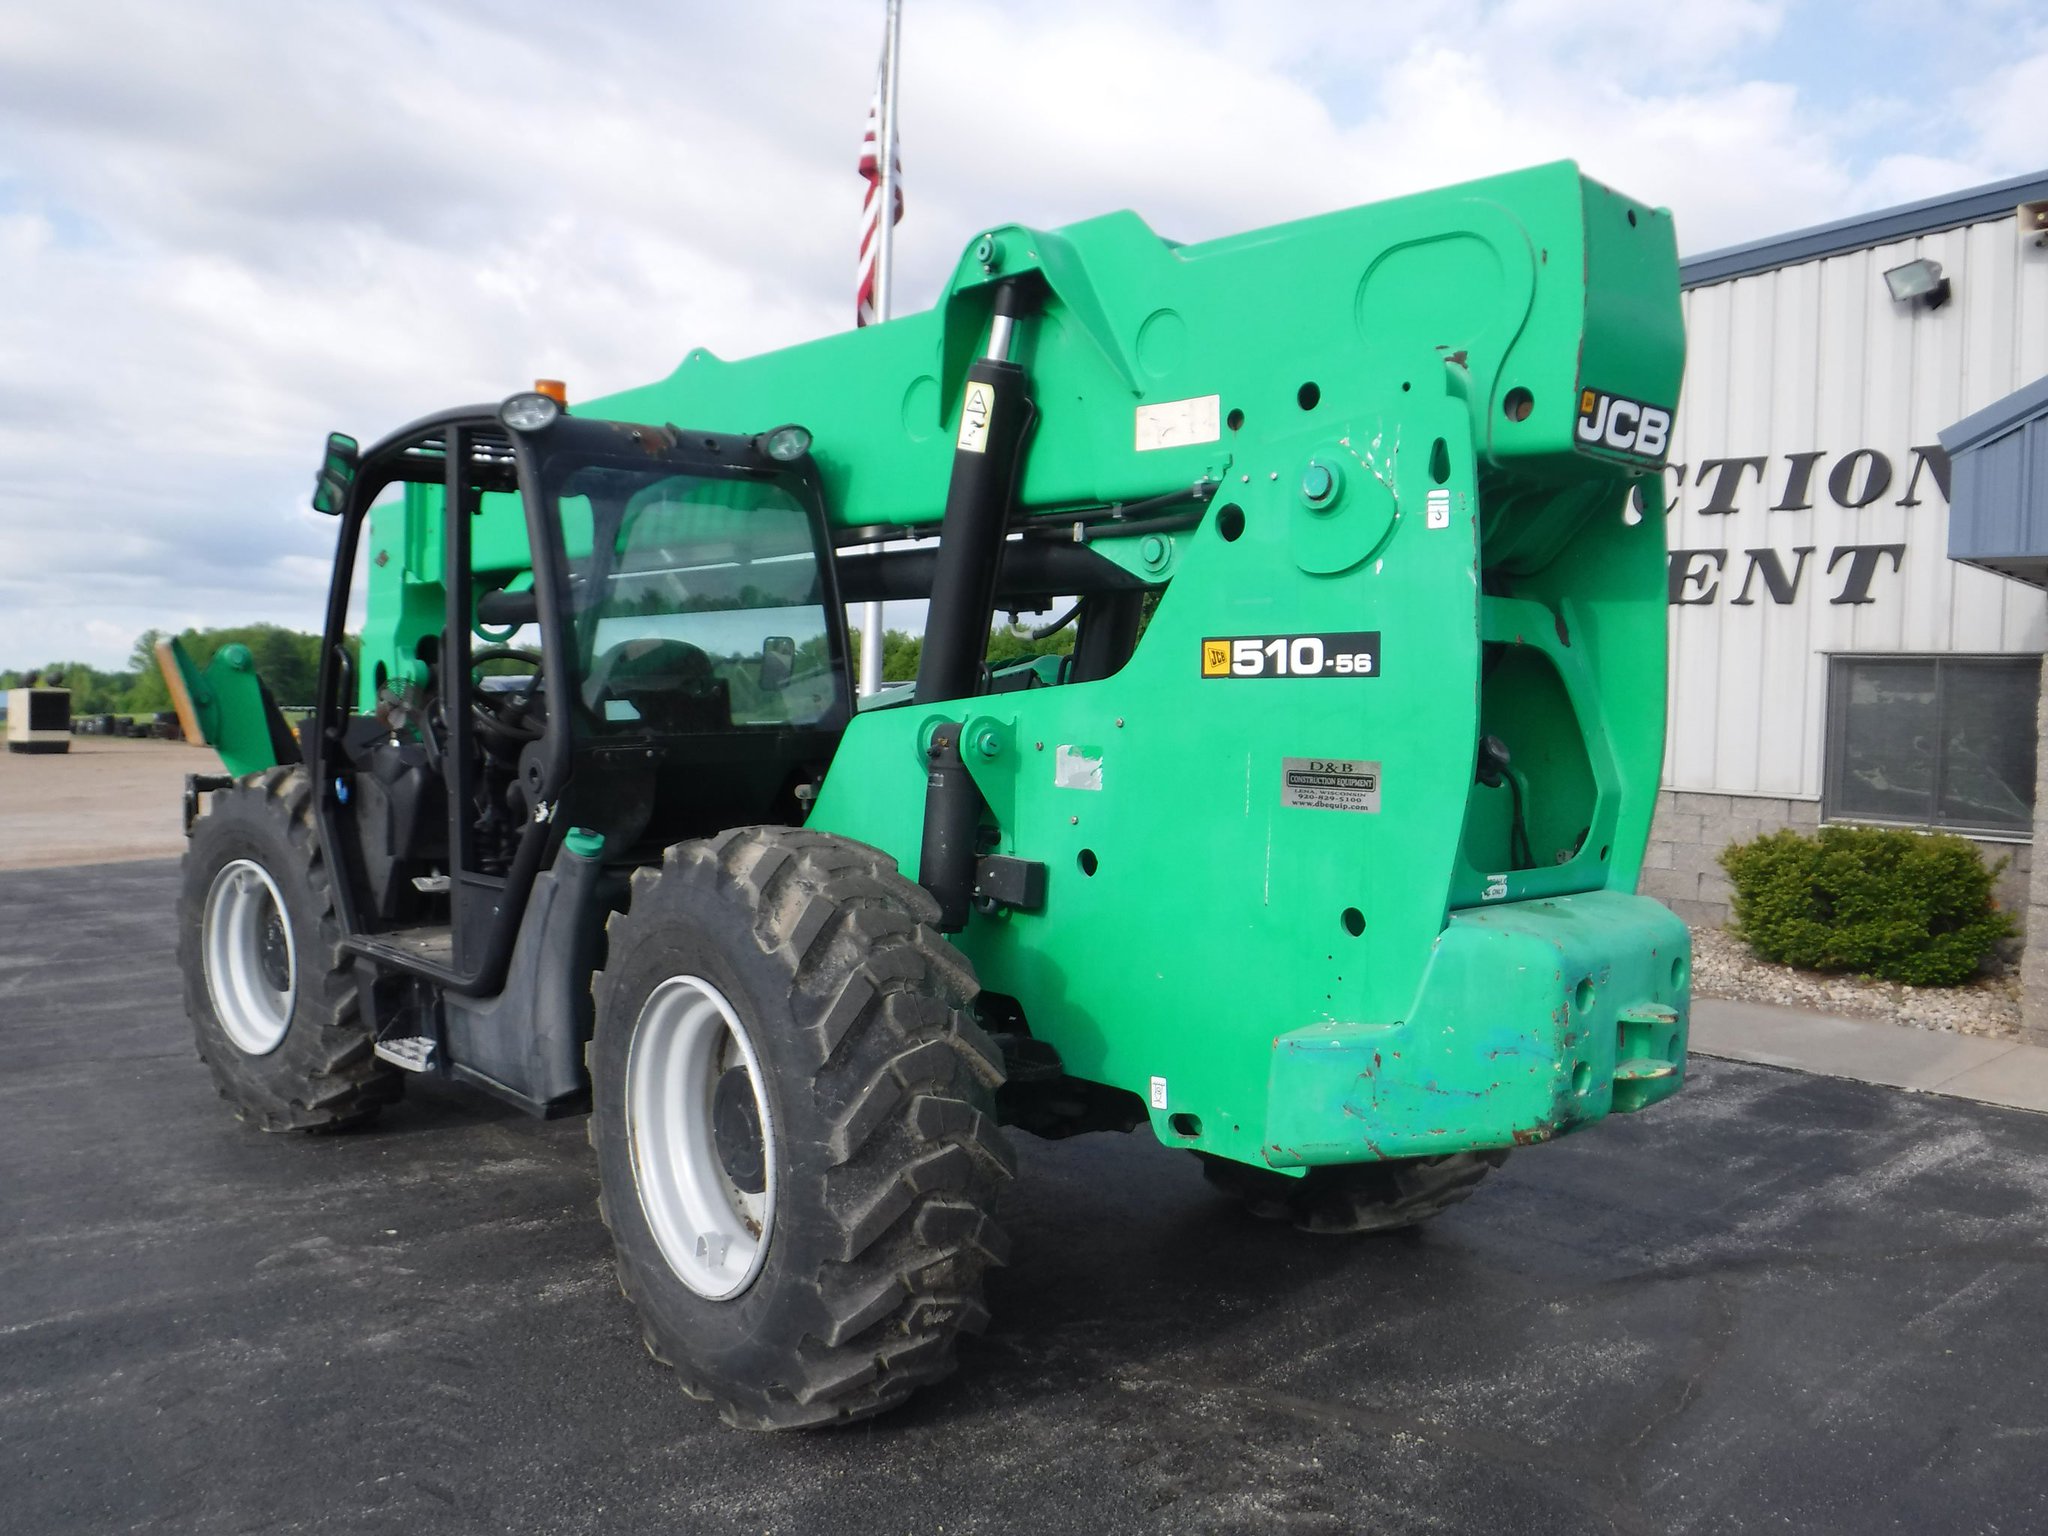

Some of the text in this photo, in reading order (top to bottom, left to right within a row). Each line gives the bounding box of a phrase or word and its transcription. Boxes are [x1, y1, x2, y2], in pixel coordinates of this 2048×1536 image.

[1578, 395, 1670, 456] JCB
[1210, 637, 1372, 675] JCB 510-56
[1291, 775, 1372, 787] CONSTRUCTION EQUIPMENT
[1298, 794, 1361, 802] 920-829-5100
[1320, 790, 1366, 798] WISCONSIN
[1292, 801, 1368, 810] www.dbequip.com
